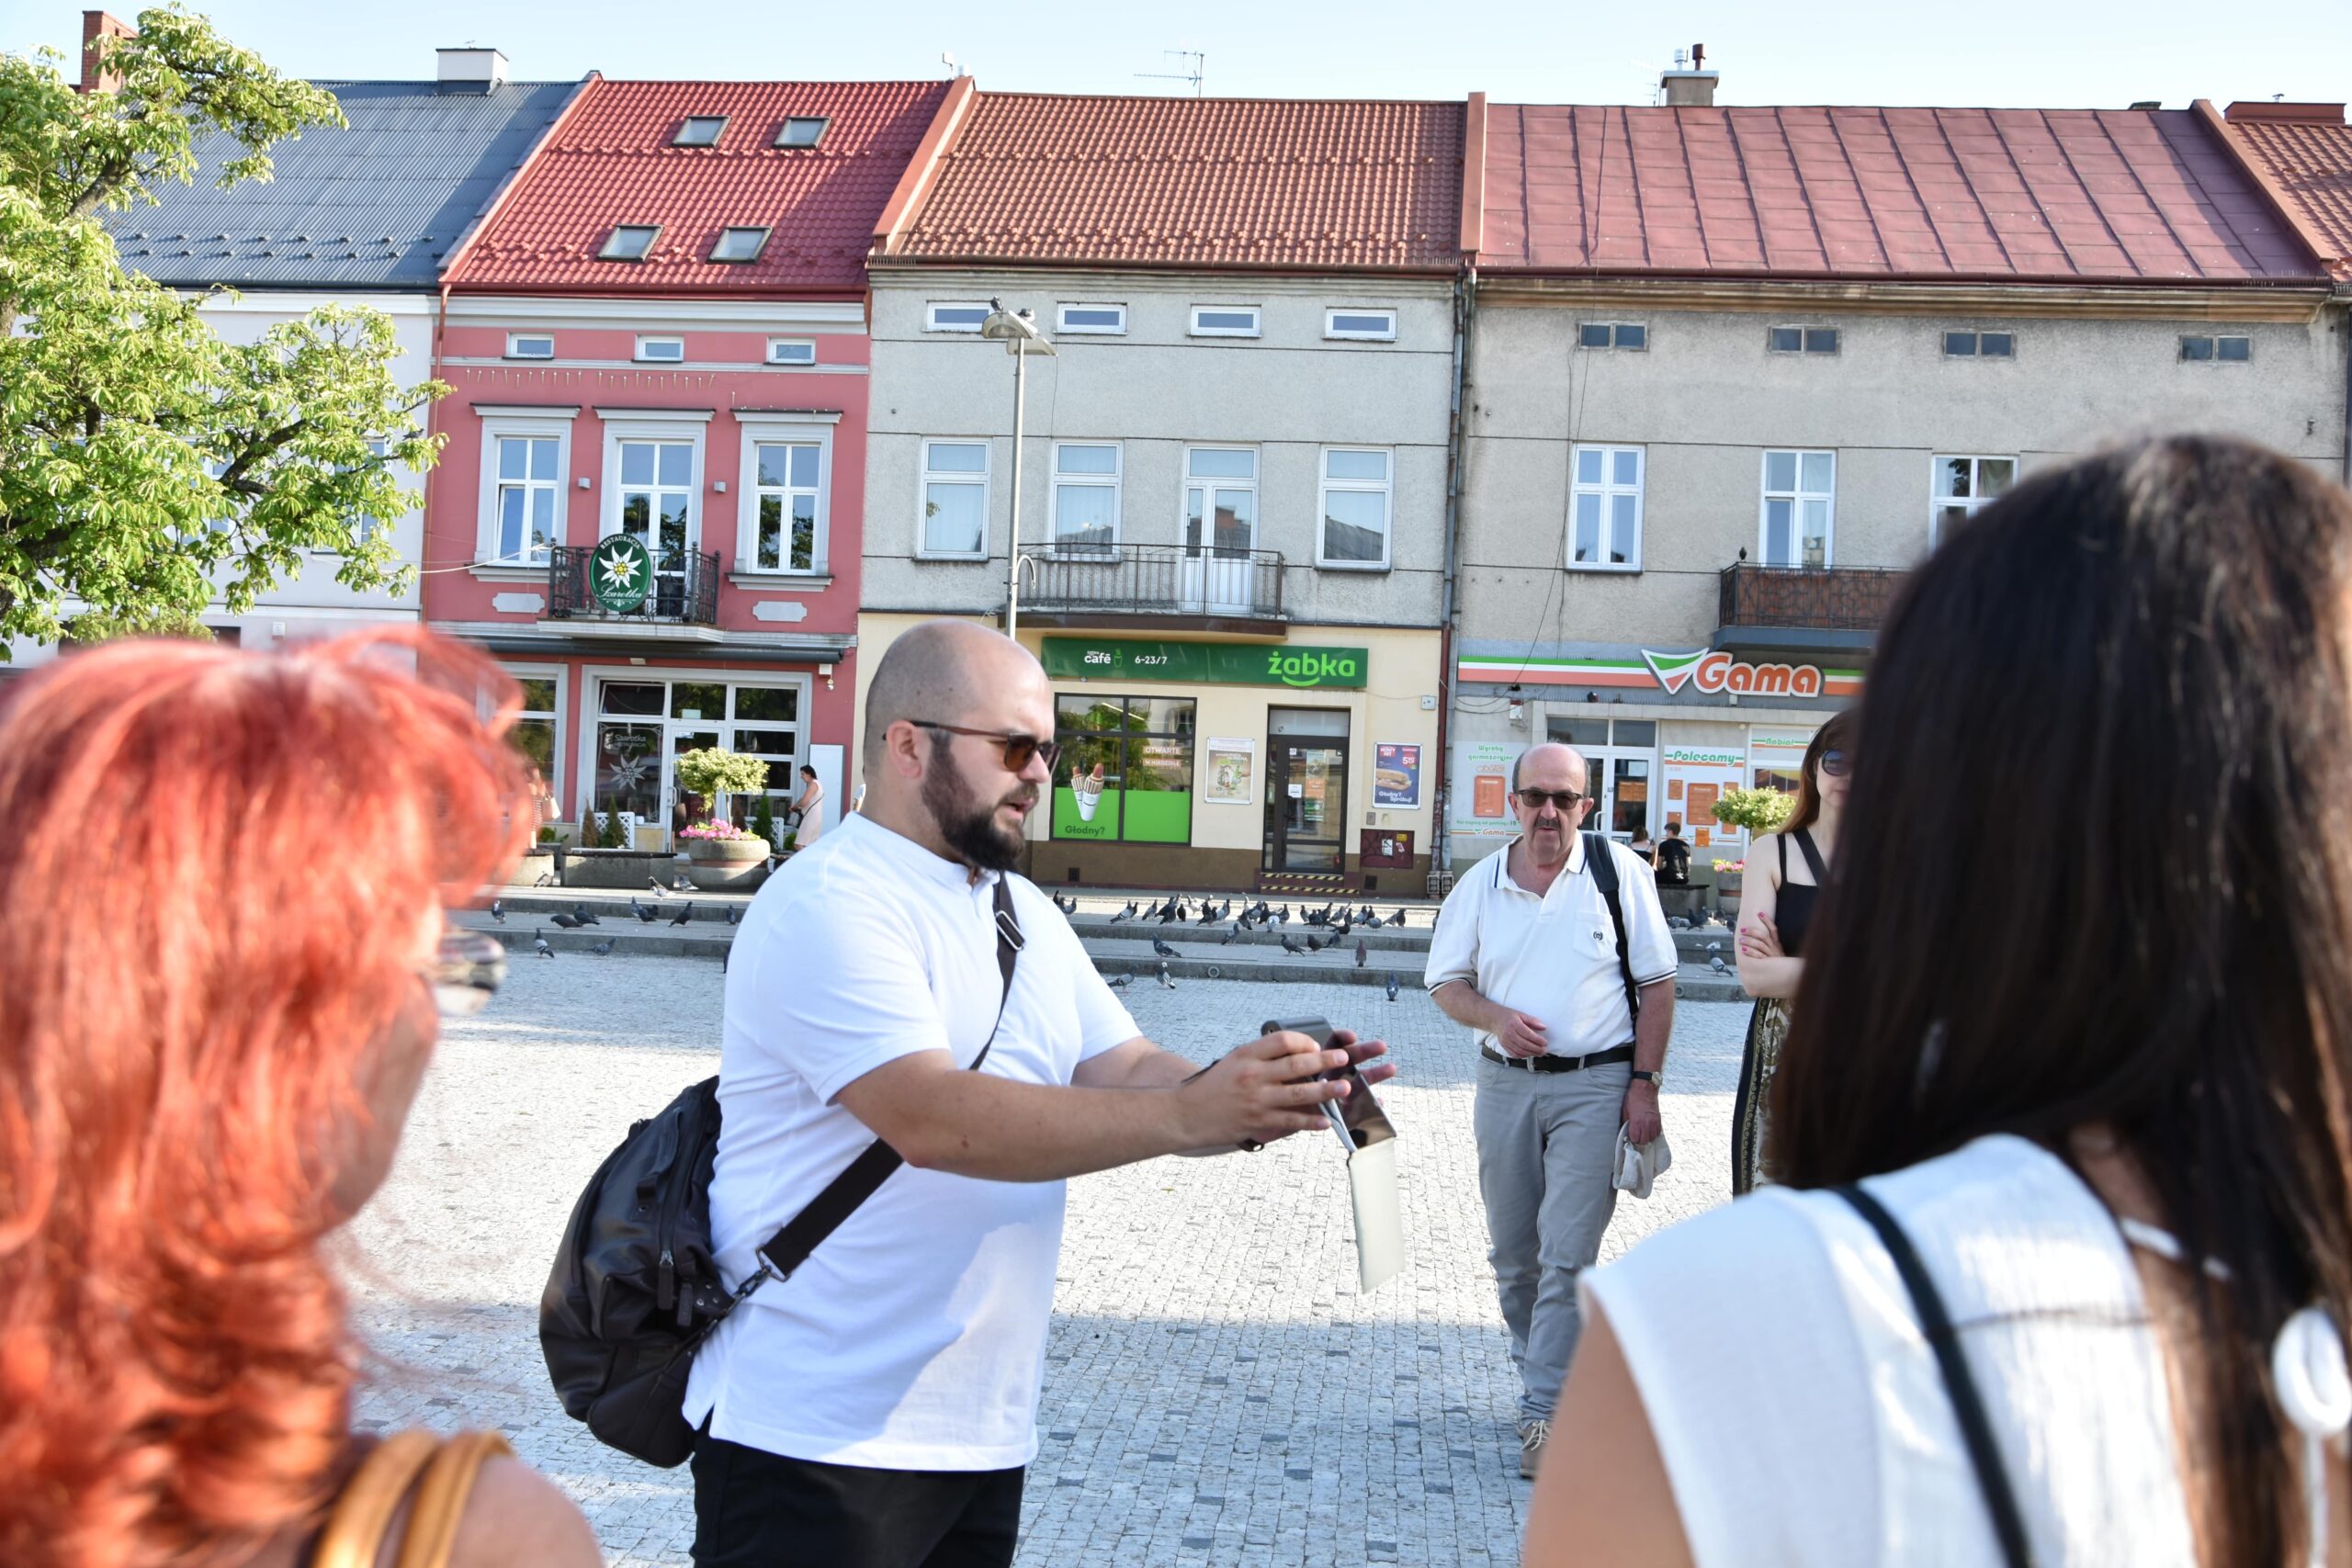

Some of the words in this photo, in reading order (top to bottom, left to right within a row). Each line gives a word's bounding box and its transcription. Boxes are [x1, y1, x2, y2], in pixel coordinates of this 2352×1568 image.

[600, 536, 641, 549] RESTAURACJA
[596, 583, 643, 598] Szarotka
[1135, 655, 1168, 665] 6-23/7
[1268, 650, 1355, 677] żabka
[1696, 654, 1818, 694] Gama
[1673, 750, 1736, 765] Polecamy
[1065, 825, 1105, 837] Głodny?
